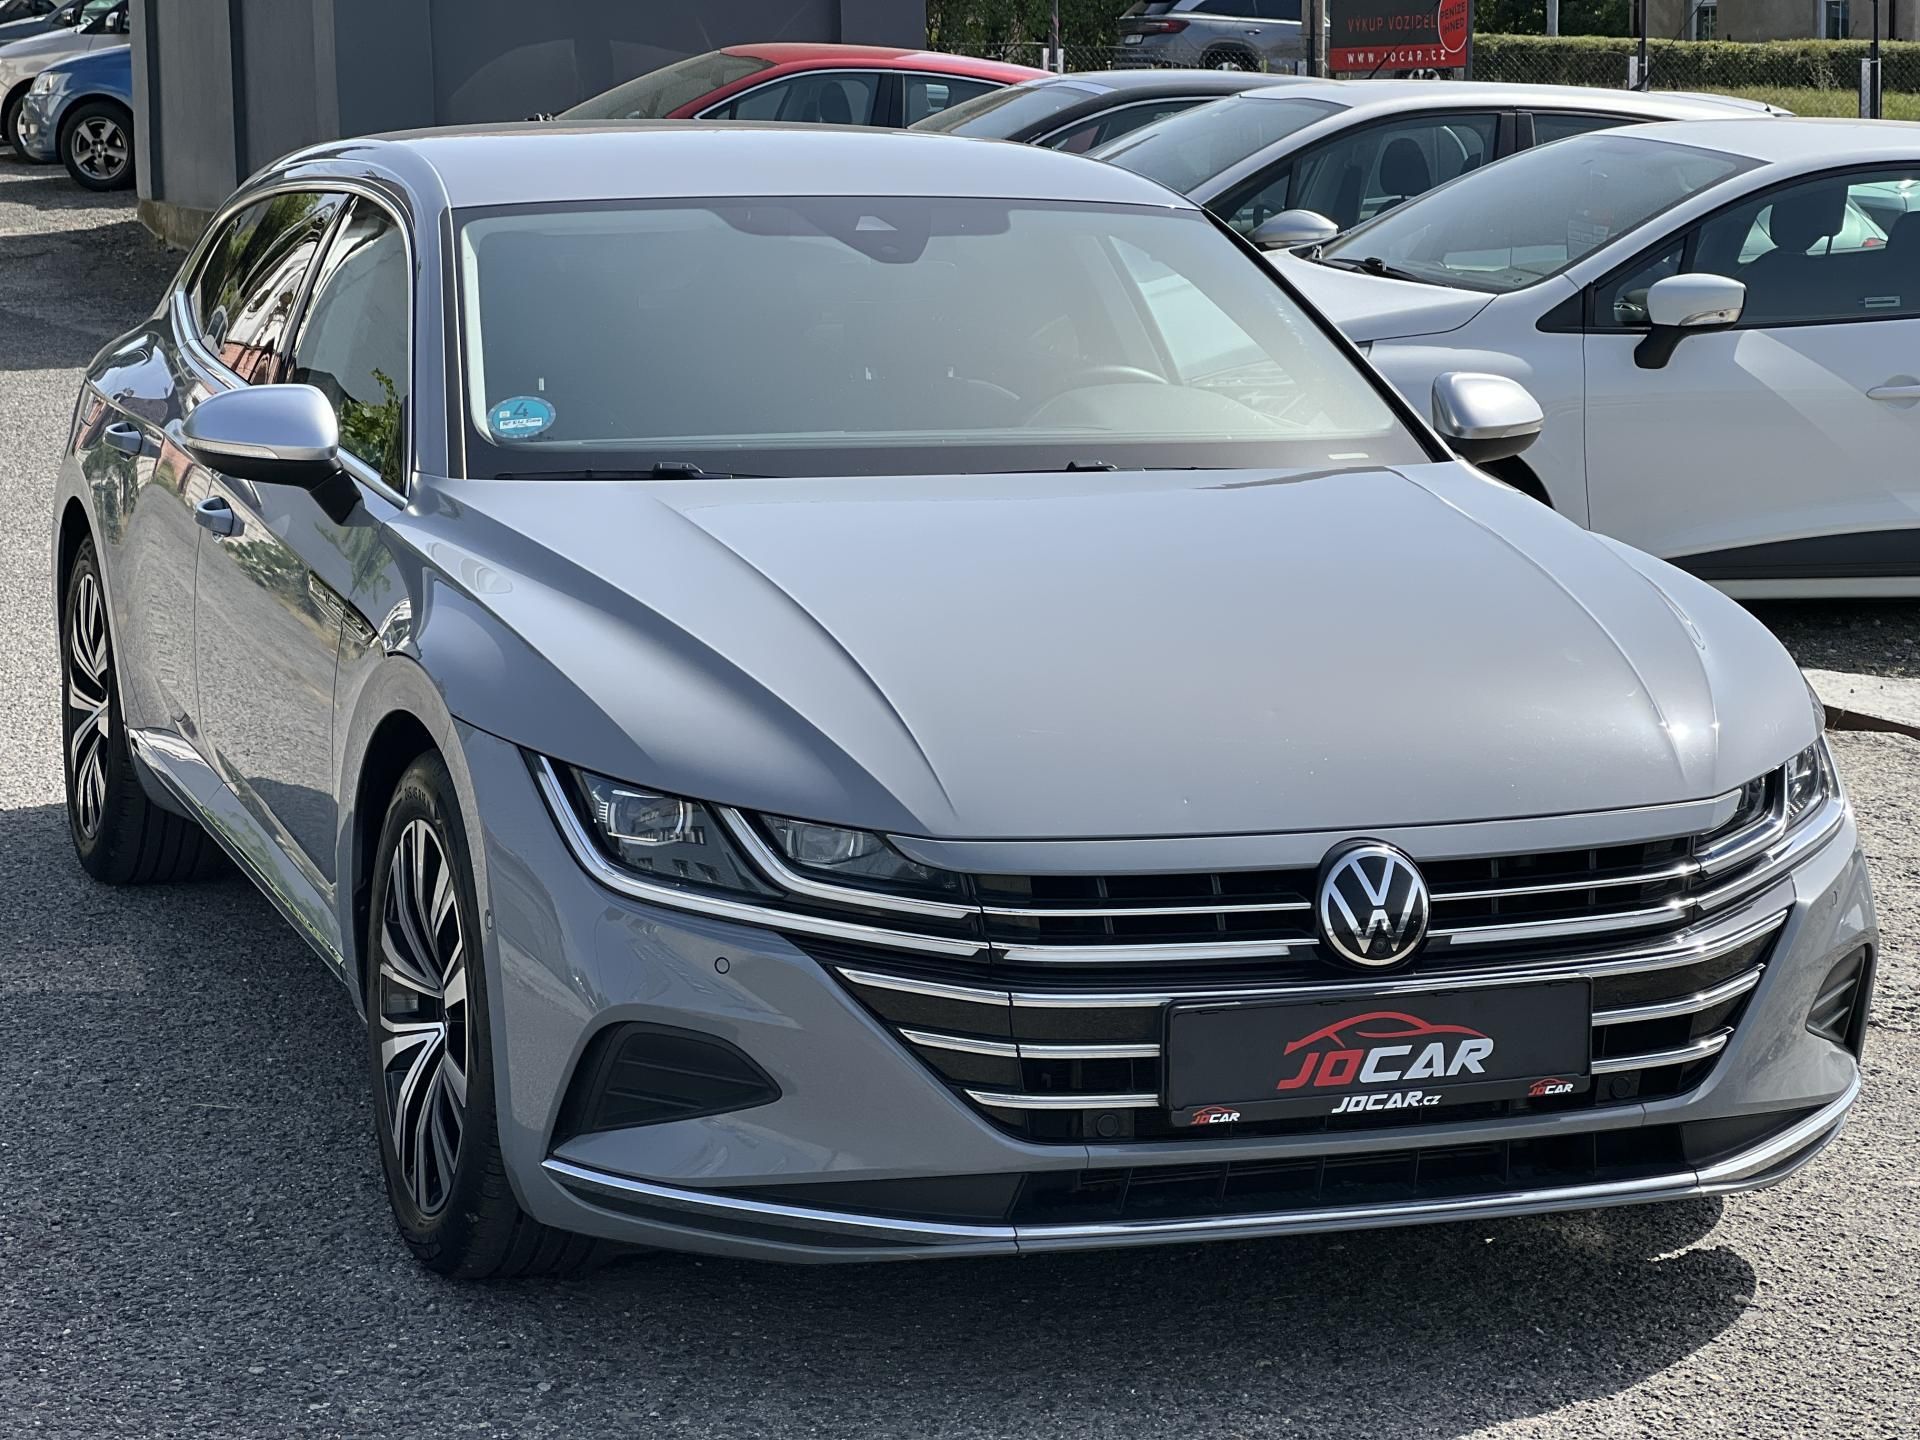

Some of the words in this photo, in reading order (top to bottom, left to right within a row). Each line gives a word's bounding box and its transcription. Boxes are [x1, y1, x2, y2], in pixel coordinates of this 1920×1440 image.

[1276, 1037, 1495, 1090] JOCAR
[1527, 1083, 1574, 1097] JOCAR
[1191, 1112, 1241, 1126] JOCAR
